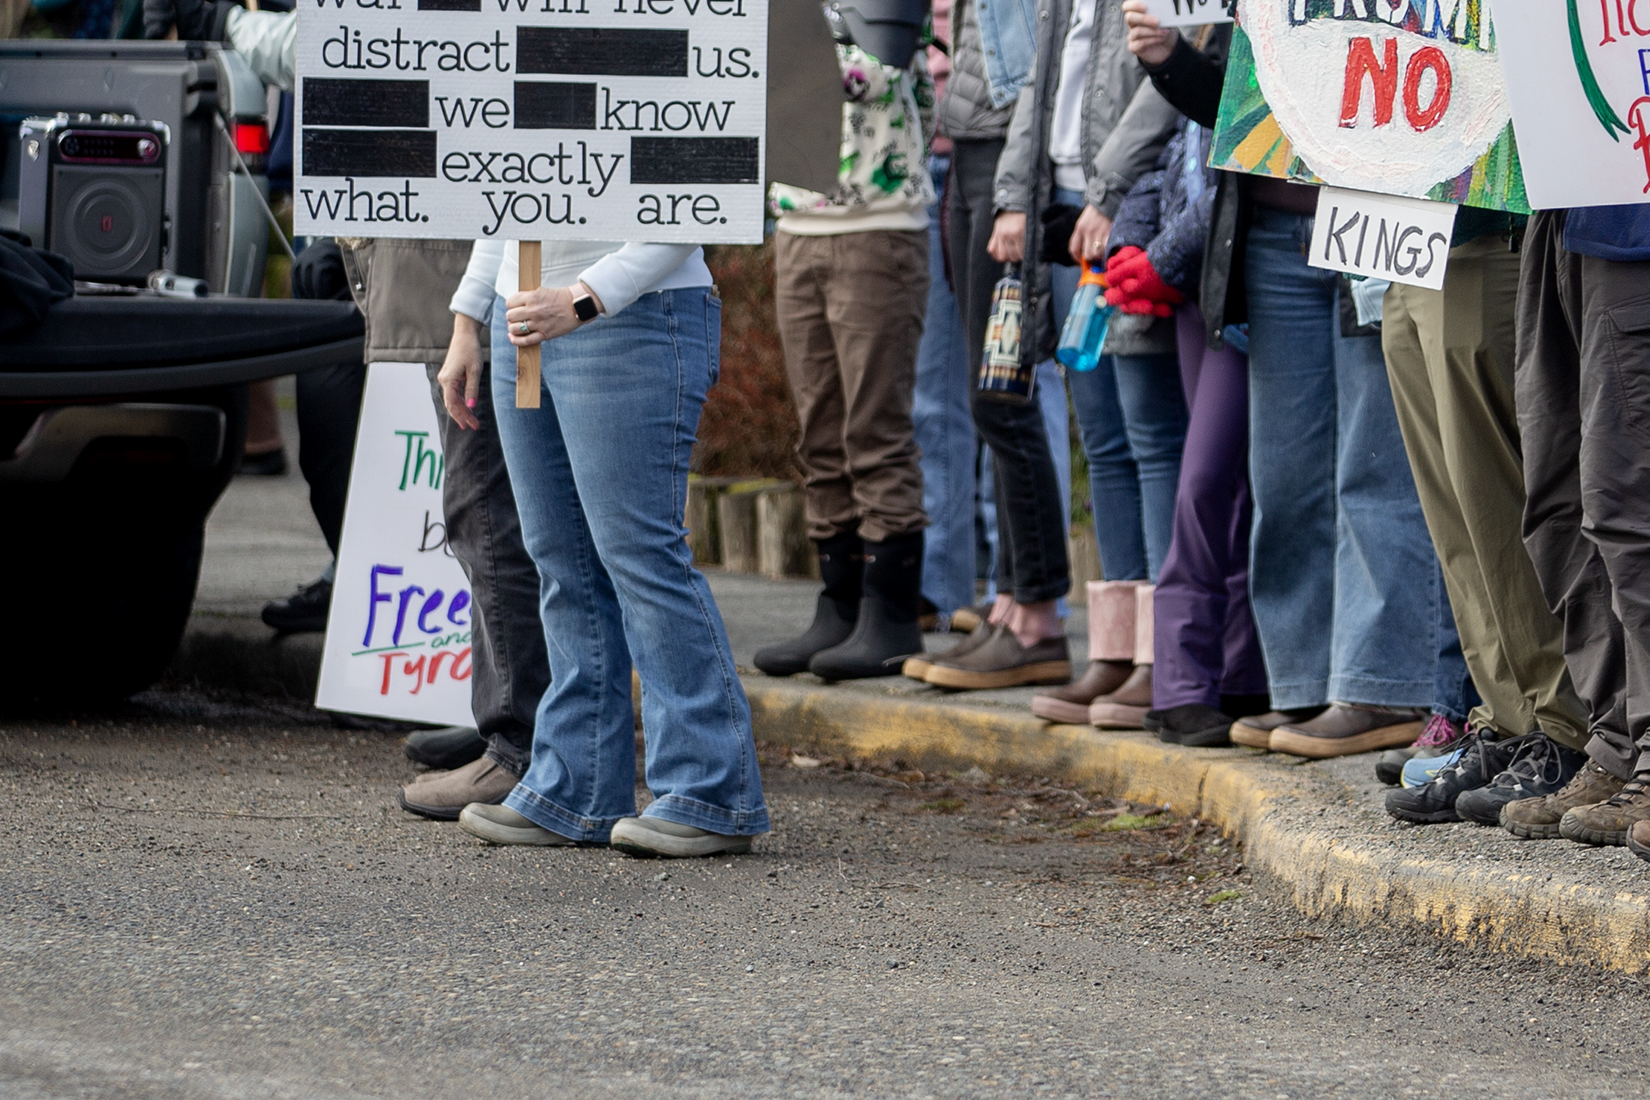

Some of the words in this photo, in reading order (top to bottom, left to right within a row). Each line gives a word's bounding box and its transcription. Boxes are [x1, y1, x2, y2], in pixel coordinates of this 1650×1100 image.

[321, 25, 511, 72] distract
[692, 45, 760, 78] us.
[435, 96, 510, 129] we
[600, 87, 735, 131] know
[1339, 36, 1452, 133] NO
[441, 141, 624, 197] exactly
[300, 177, 429, 223] what.
[481, 189, 587, 236] you.
[636, 193, 727, 225] are.
[1324, 206, 1447, 278] KINGS
[363, 563, 472, 647] Free
